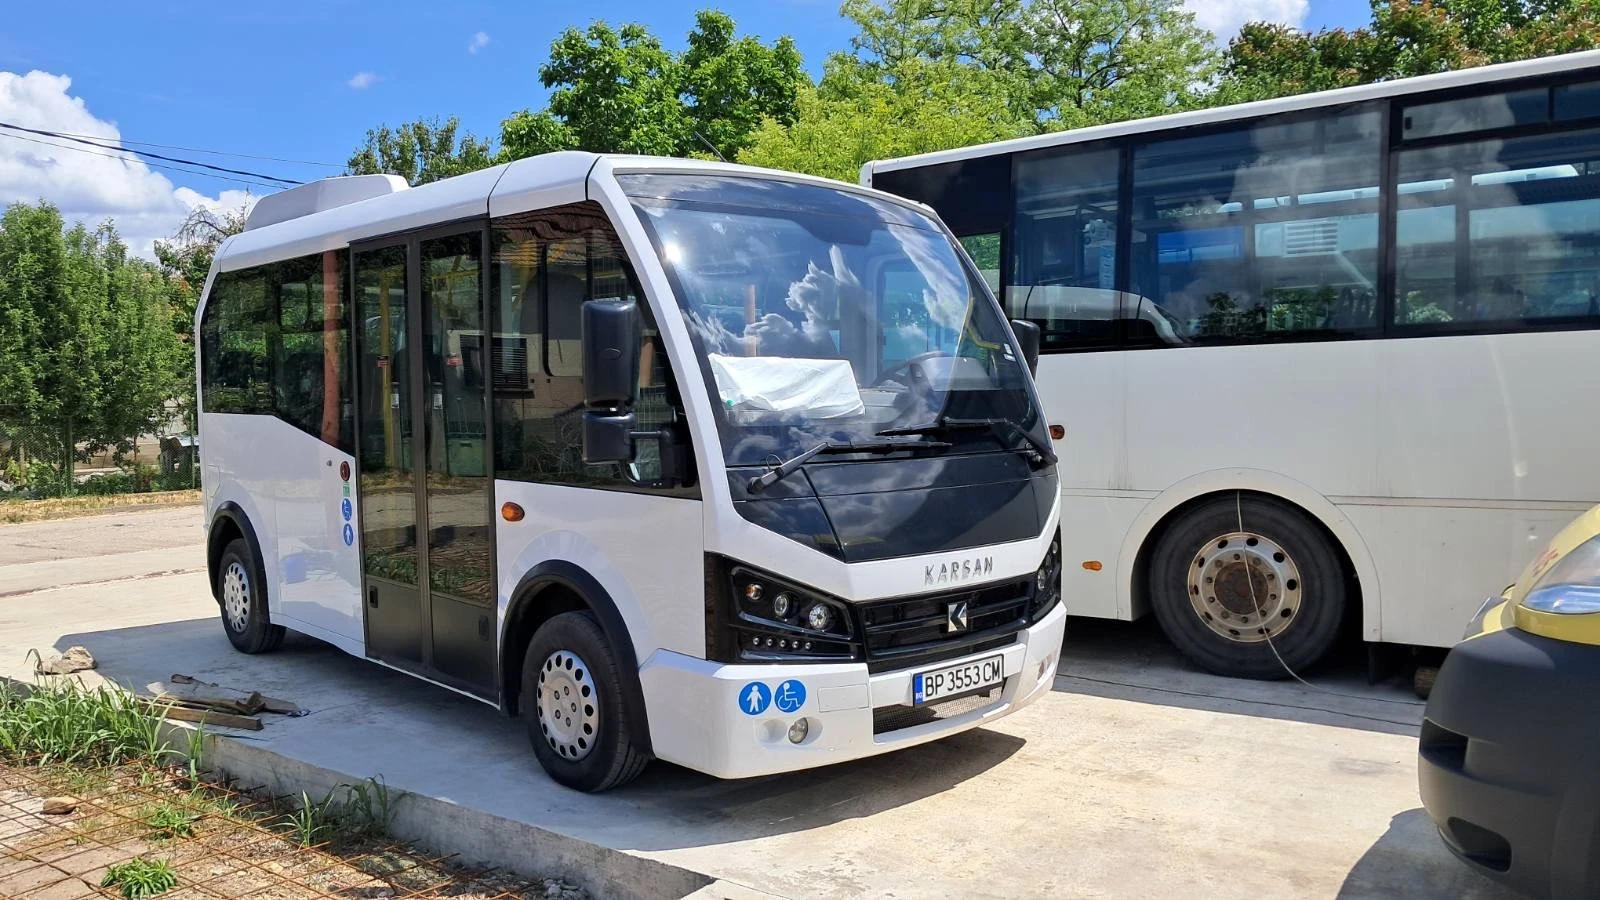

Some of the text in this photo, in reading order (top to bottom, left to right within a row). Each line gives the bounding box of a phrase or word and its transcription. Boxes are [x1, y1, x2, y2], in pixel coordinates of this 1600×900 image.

[925, 556, 993, 585] KARSAN
[925, 660, 1000, 697] BP 3553 CM
